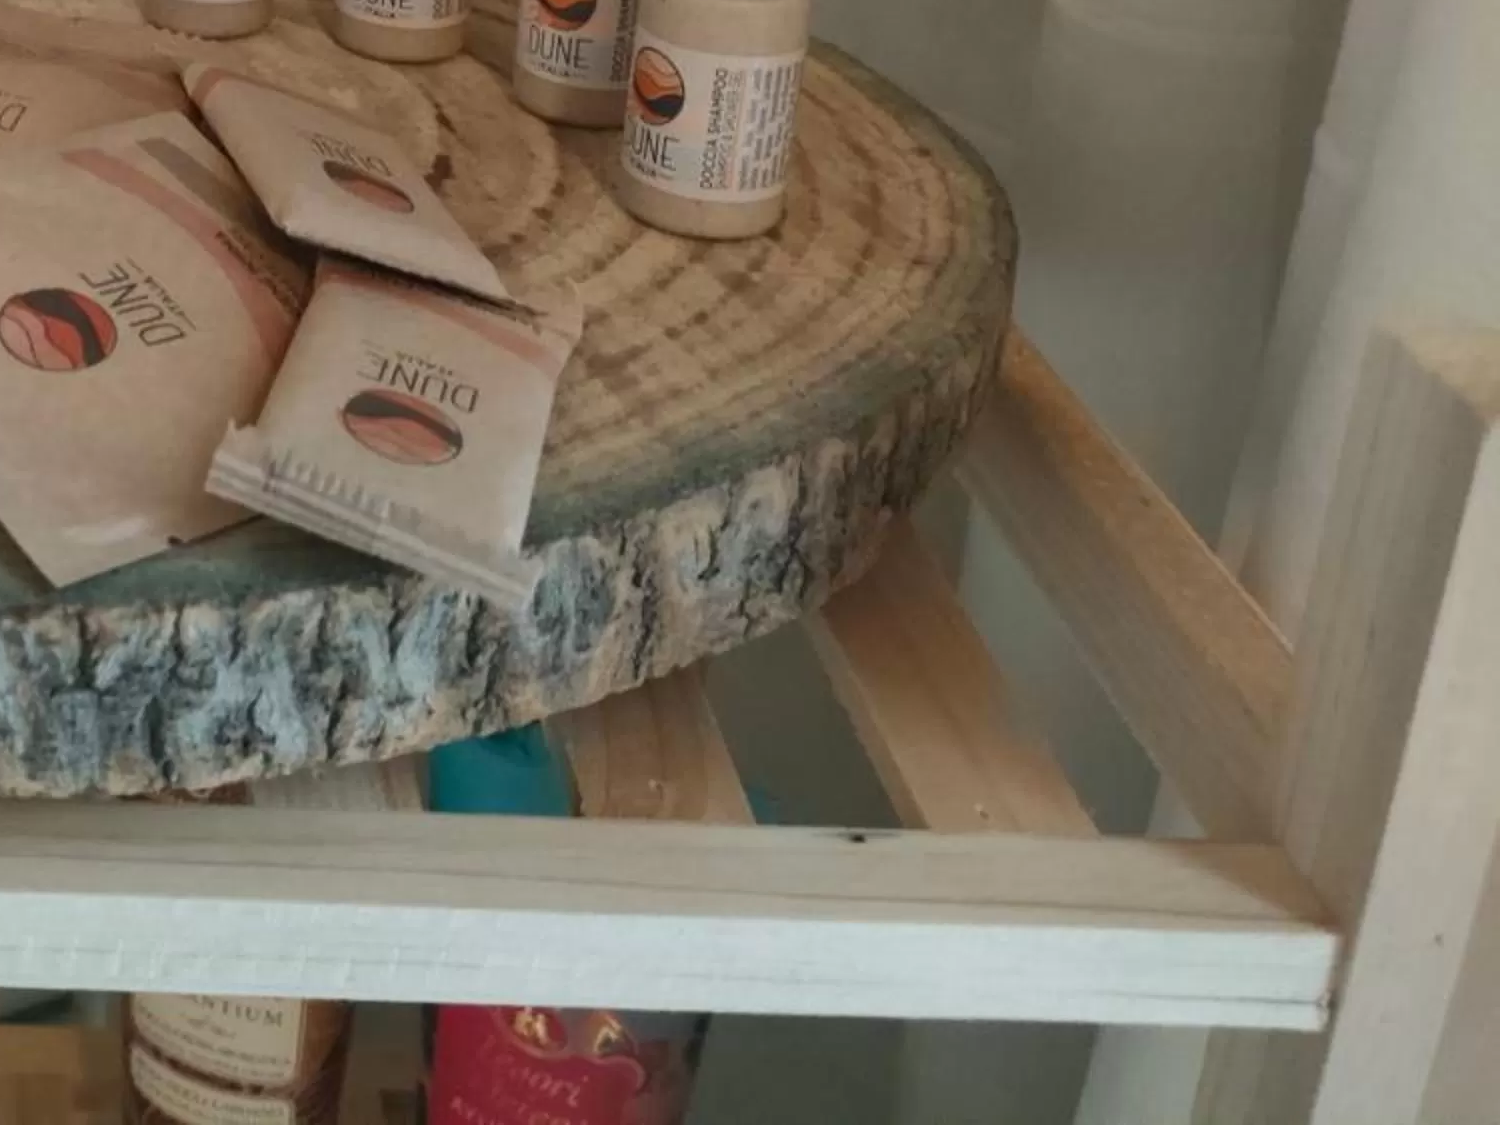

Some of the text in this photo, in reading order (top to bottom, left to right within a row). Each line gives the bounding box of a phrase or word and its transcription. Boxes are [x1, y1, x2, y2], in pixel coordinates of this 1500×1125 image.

[529, 24, 595, 69] DUNE
[699, 67, 728, 189] DOCCIA SHAMPOO
[78, 262, 187, 346] DUNE
[356, 348, 479, 414] DUNE
